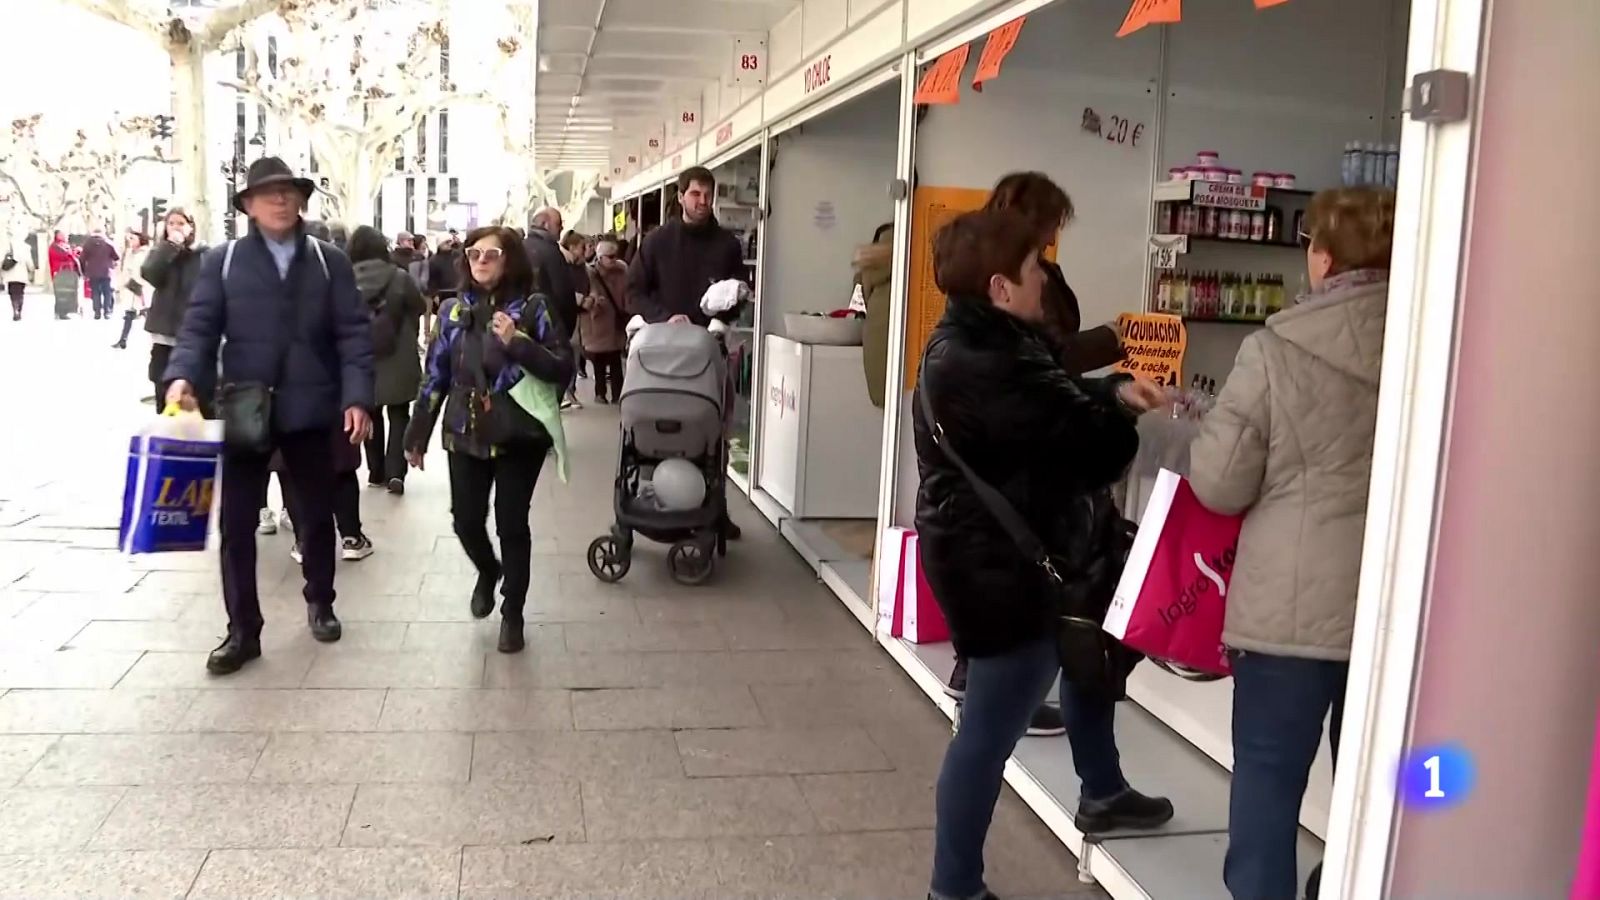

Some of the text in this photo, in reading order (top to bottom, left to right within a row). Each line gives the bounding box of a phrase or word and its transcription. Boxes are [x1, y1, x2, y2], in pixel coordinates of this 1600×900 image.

[741, 54, 758, 70] 83
[682, 111, 695, 123] 84
[1106, 114, 1144, 147] 20 €
[1208, 184, 1246, 196] CREMA DE
[1194, 193, 1260, 208] ROSA MOSQUETA
[1121, 358, 1170, 373] de coche
[151, 510, 190, 526] TEXTIL
